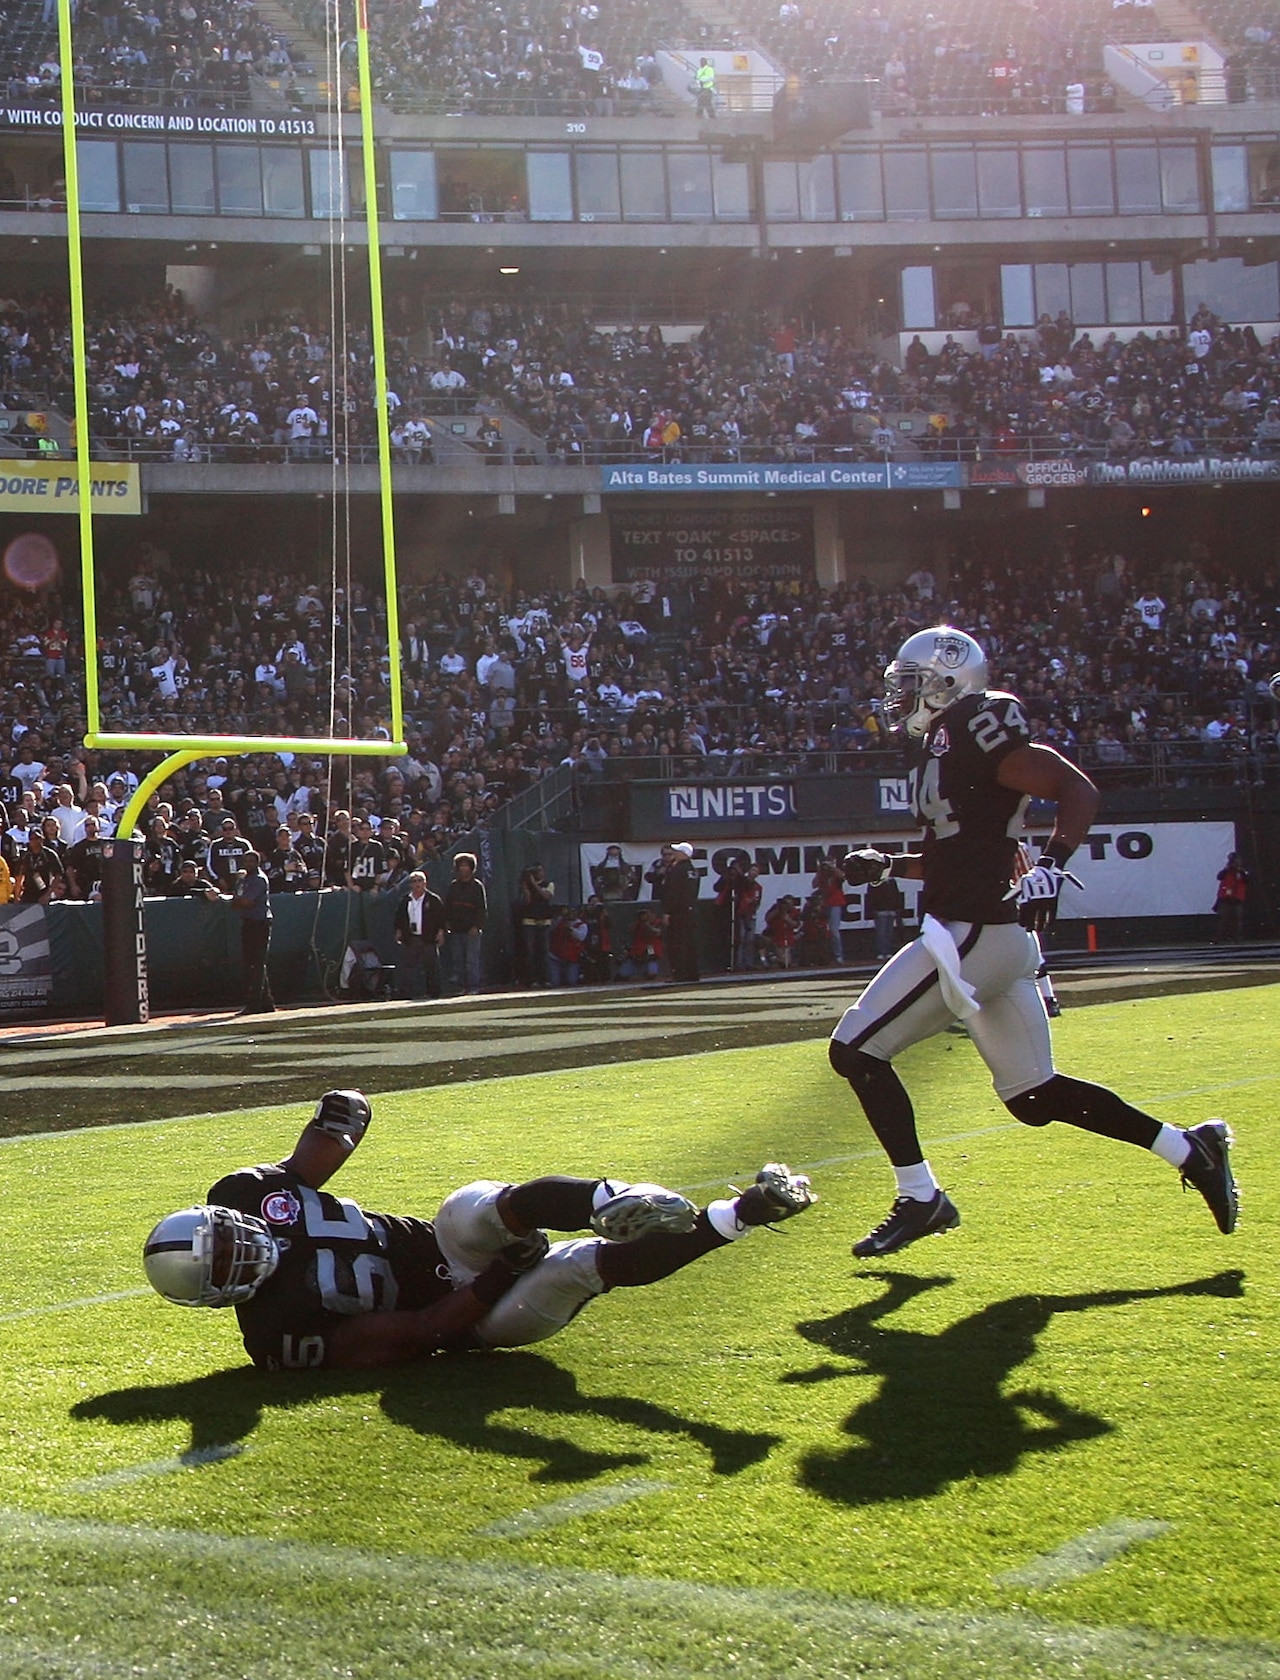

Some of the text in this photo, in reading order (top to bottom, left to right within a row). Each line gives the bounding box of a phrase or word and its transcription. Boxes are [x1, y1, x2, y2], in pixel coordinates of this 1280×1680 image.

[7, 109, 41, 125] WITH
[44, 111, 104, 128] CODUCT
[107, 113, 164, 130] CONCERN
[167, 115, 194, 131] AND
[197, 116, 256, 133] LOCATION
[259, 118, 276, 133] TO
[278, 119, 315, 135] 41513
[566, 123, 586, 133] 310
[1026, 462, 1076, 474] OFFICIAL
[1077, 466, 1089, 478] of
[609, 469, 884, 485] Alta Bates Summit Medical Center
[1026, 473, 1076, 485] GROCER
[55, 475, 129, 498] PANTS
[621, 531, 662, 545] TEXT
[674, 548, 755, 563] TO 41513
[832, 633, 847, 646] 32
[967, 701, 1030, 753] 24
[0, 786, 18, 804] 34
[909, 758, 961, 841] 4
[1082, 831, 1154, 861] TO
[132, 862, 150, 1024] RAIDERS
